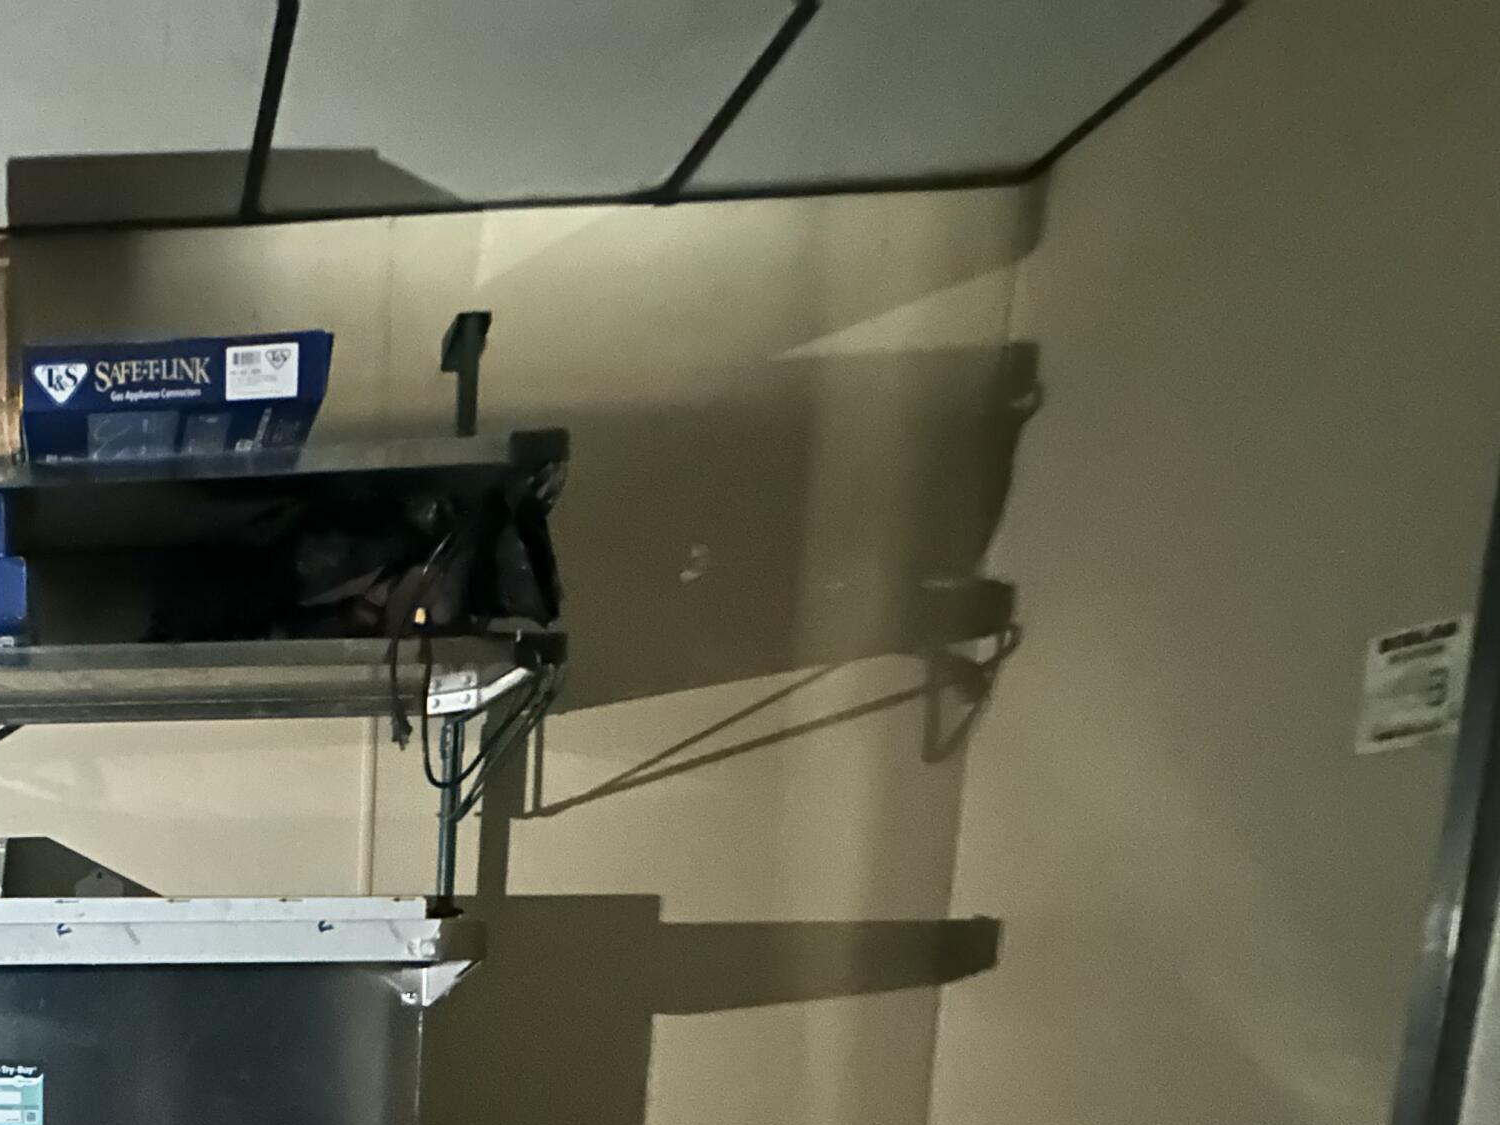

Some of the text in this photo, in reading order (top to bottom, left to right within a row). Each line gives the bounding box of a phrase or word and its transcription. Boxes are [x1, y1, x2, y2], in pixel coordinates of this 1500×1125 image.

[45, 366, 79, 392] T&S
[125, 389, 160, 403] Appliance
[161, 387, 202, 399] Connectors
